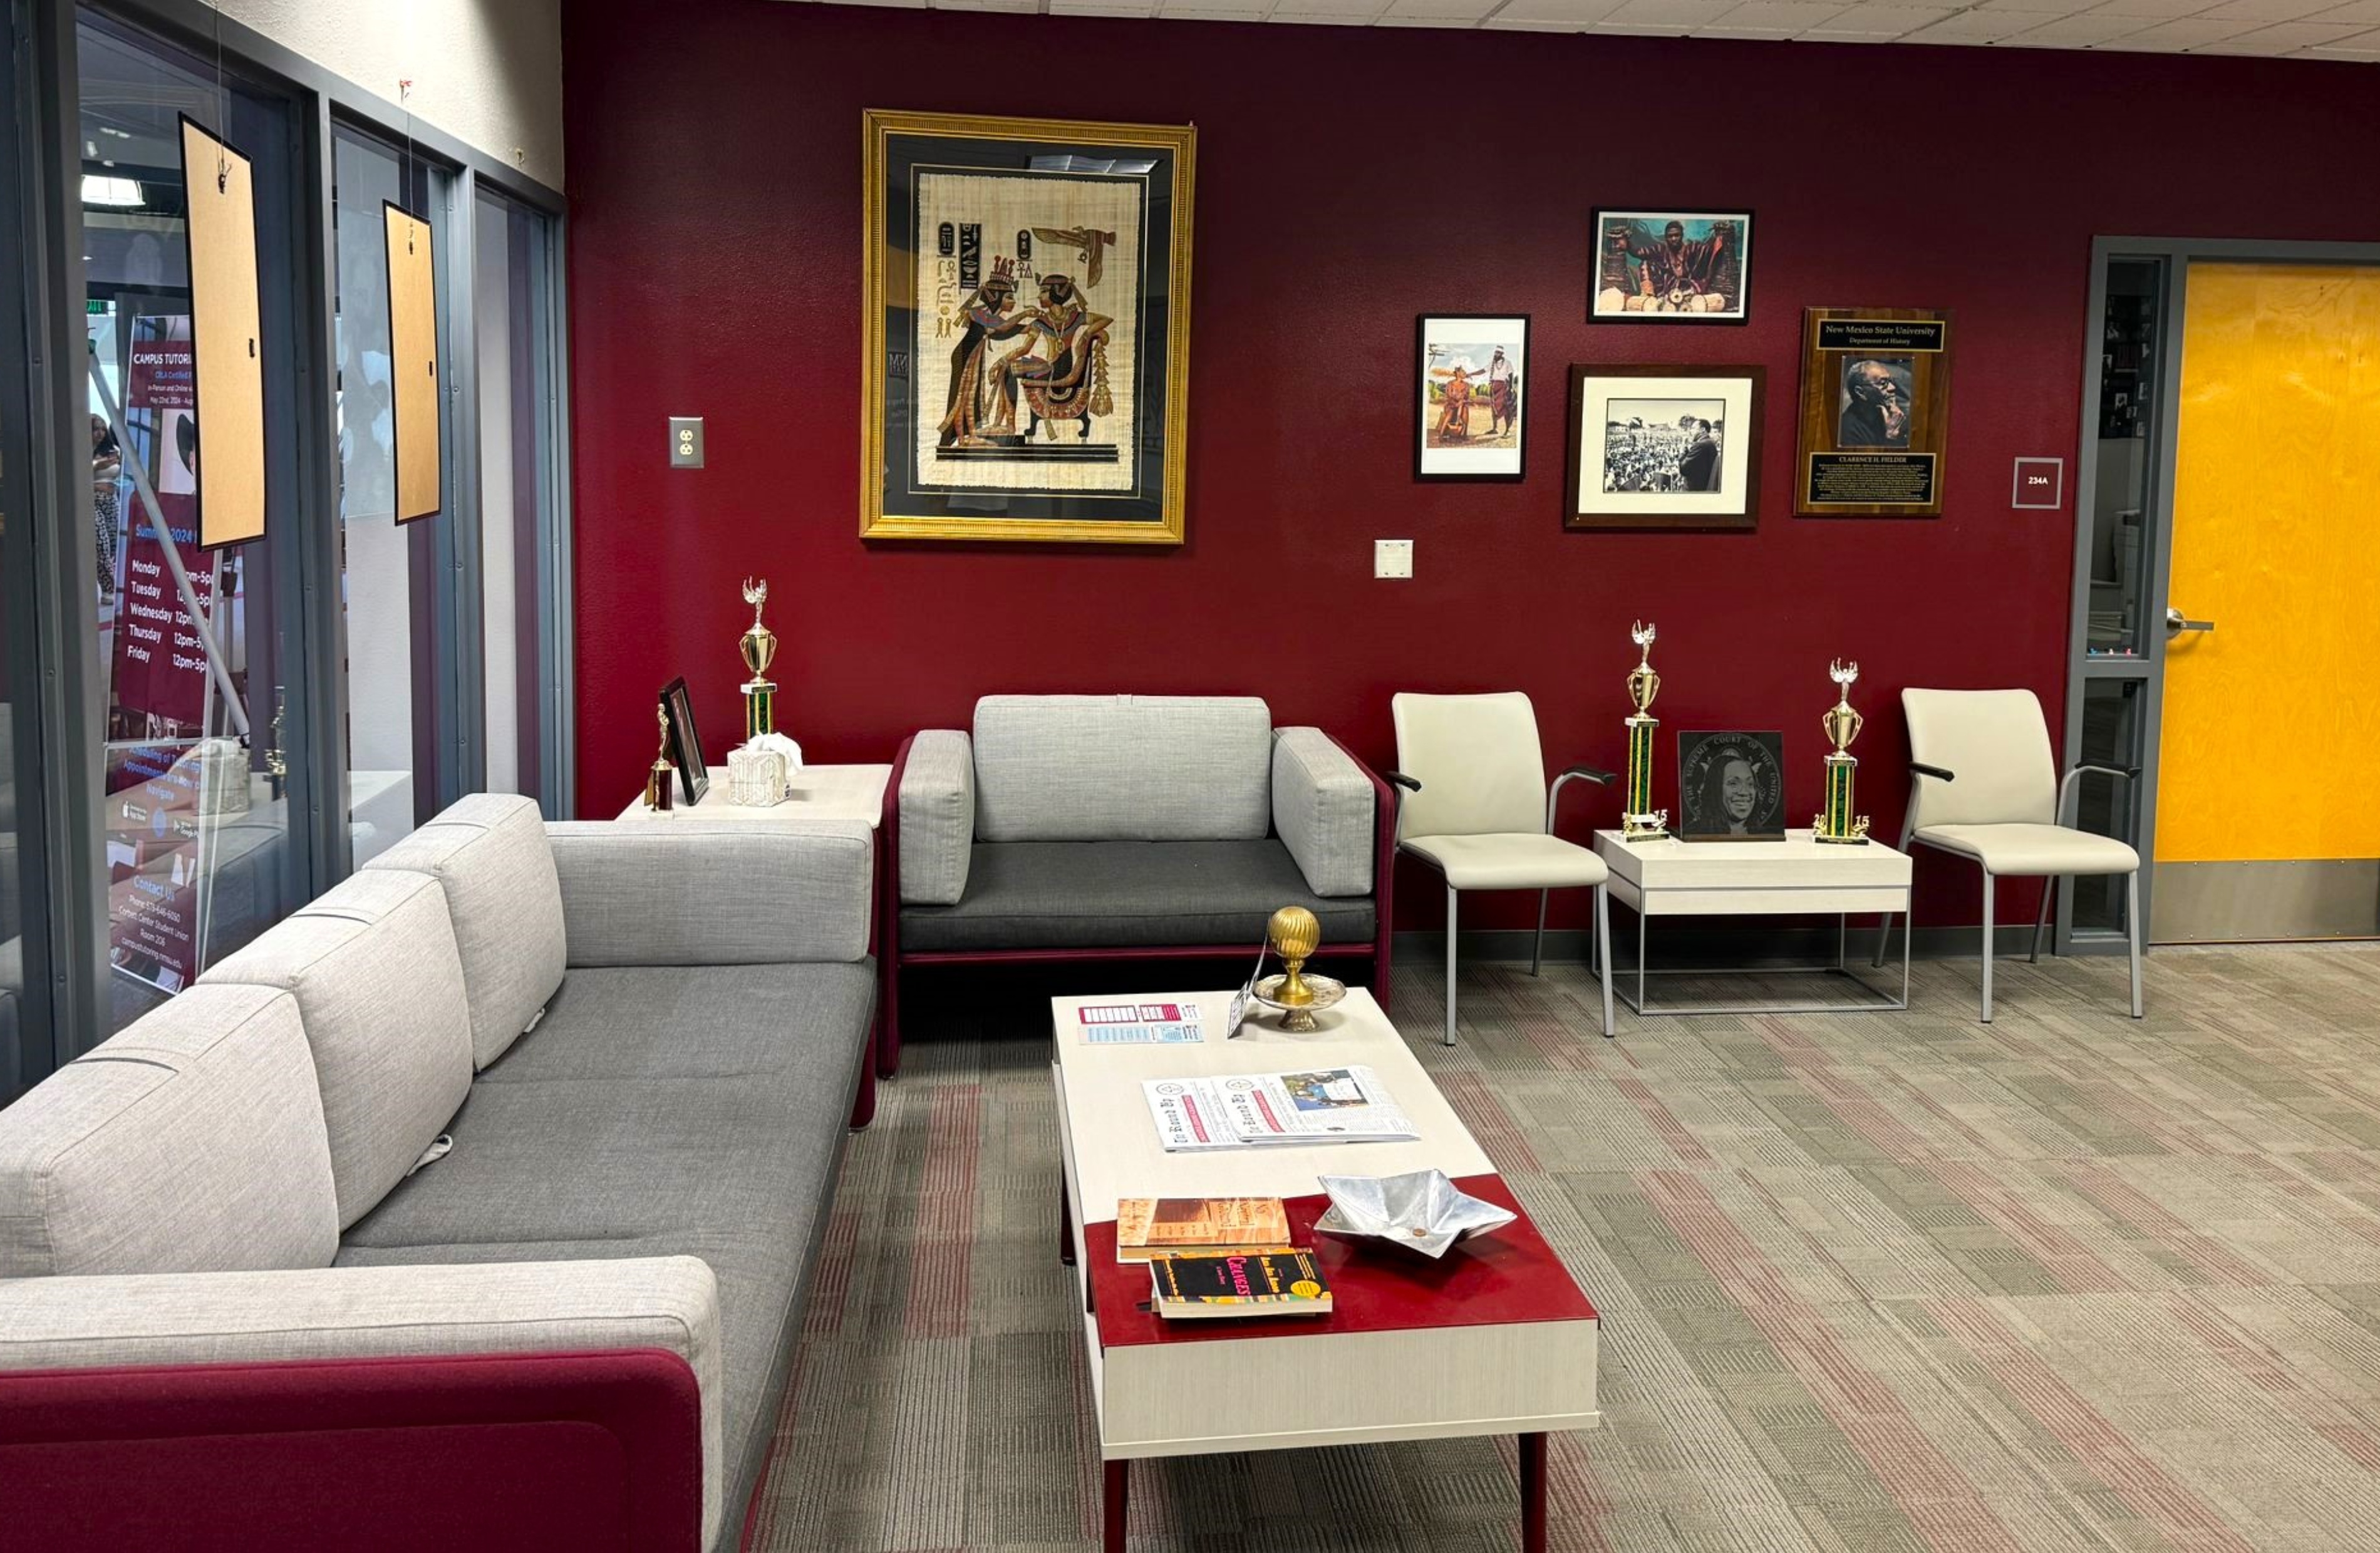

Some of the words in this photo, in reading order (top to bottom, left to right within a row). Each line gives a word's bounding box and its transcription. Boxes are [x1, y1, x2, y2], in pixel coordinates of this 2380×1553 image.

[87, 301, 102, 311] XIT
[1826, 326, 1844, 334] New
[1895, 327, 1935, 337] University
[133, 354, 163, 364] CAMPUS
[2028, 476, 2048, 485] 234A
[132, 559, 161, 577] Monday
[131, 580, 161, 599] Tuesday
[130, 602, 173, 624] Wednesday
[128, 624, 162, 644] Thursday
[127, 645, 150, 663] Friday
[1855, 815, 1870, 827] 15
